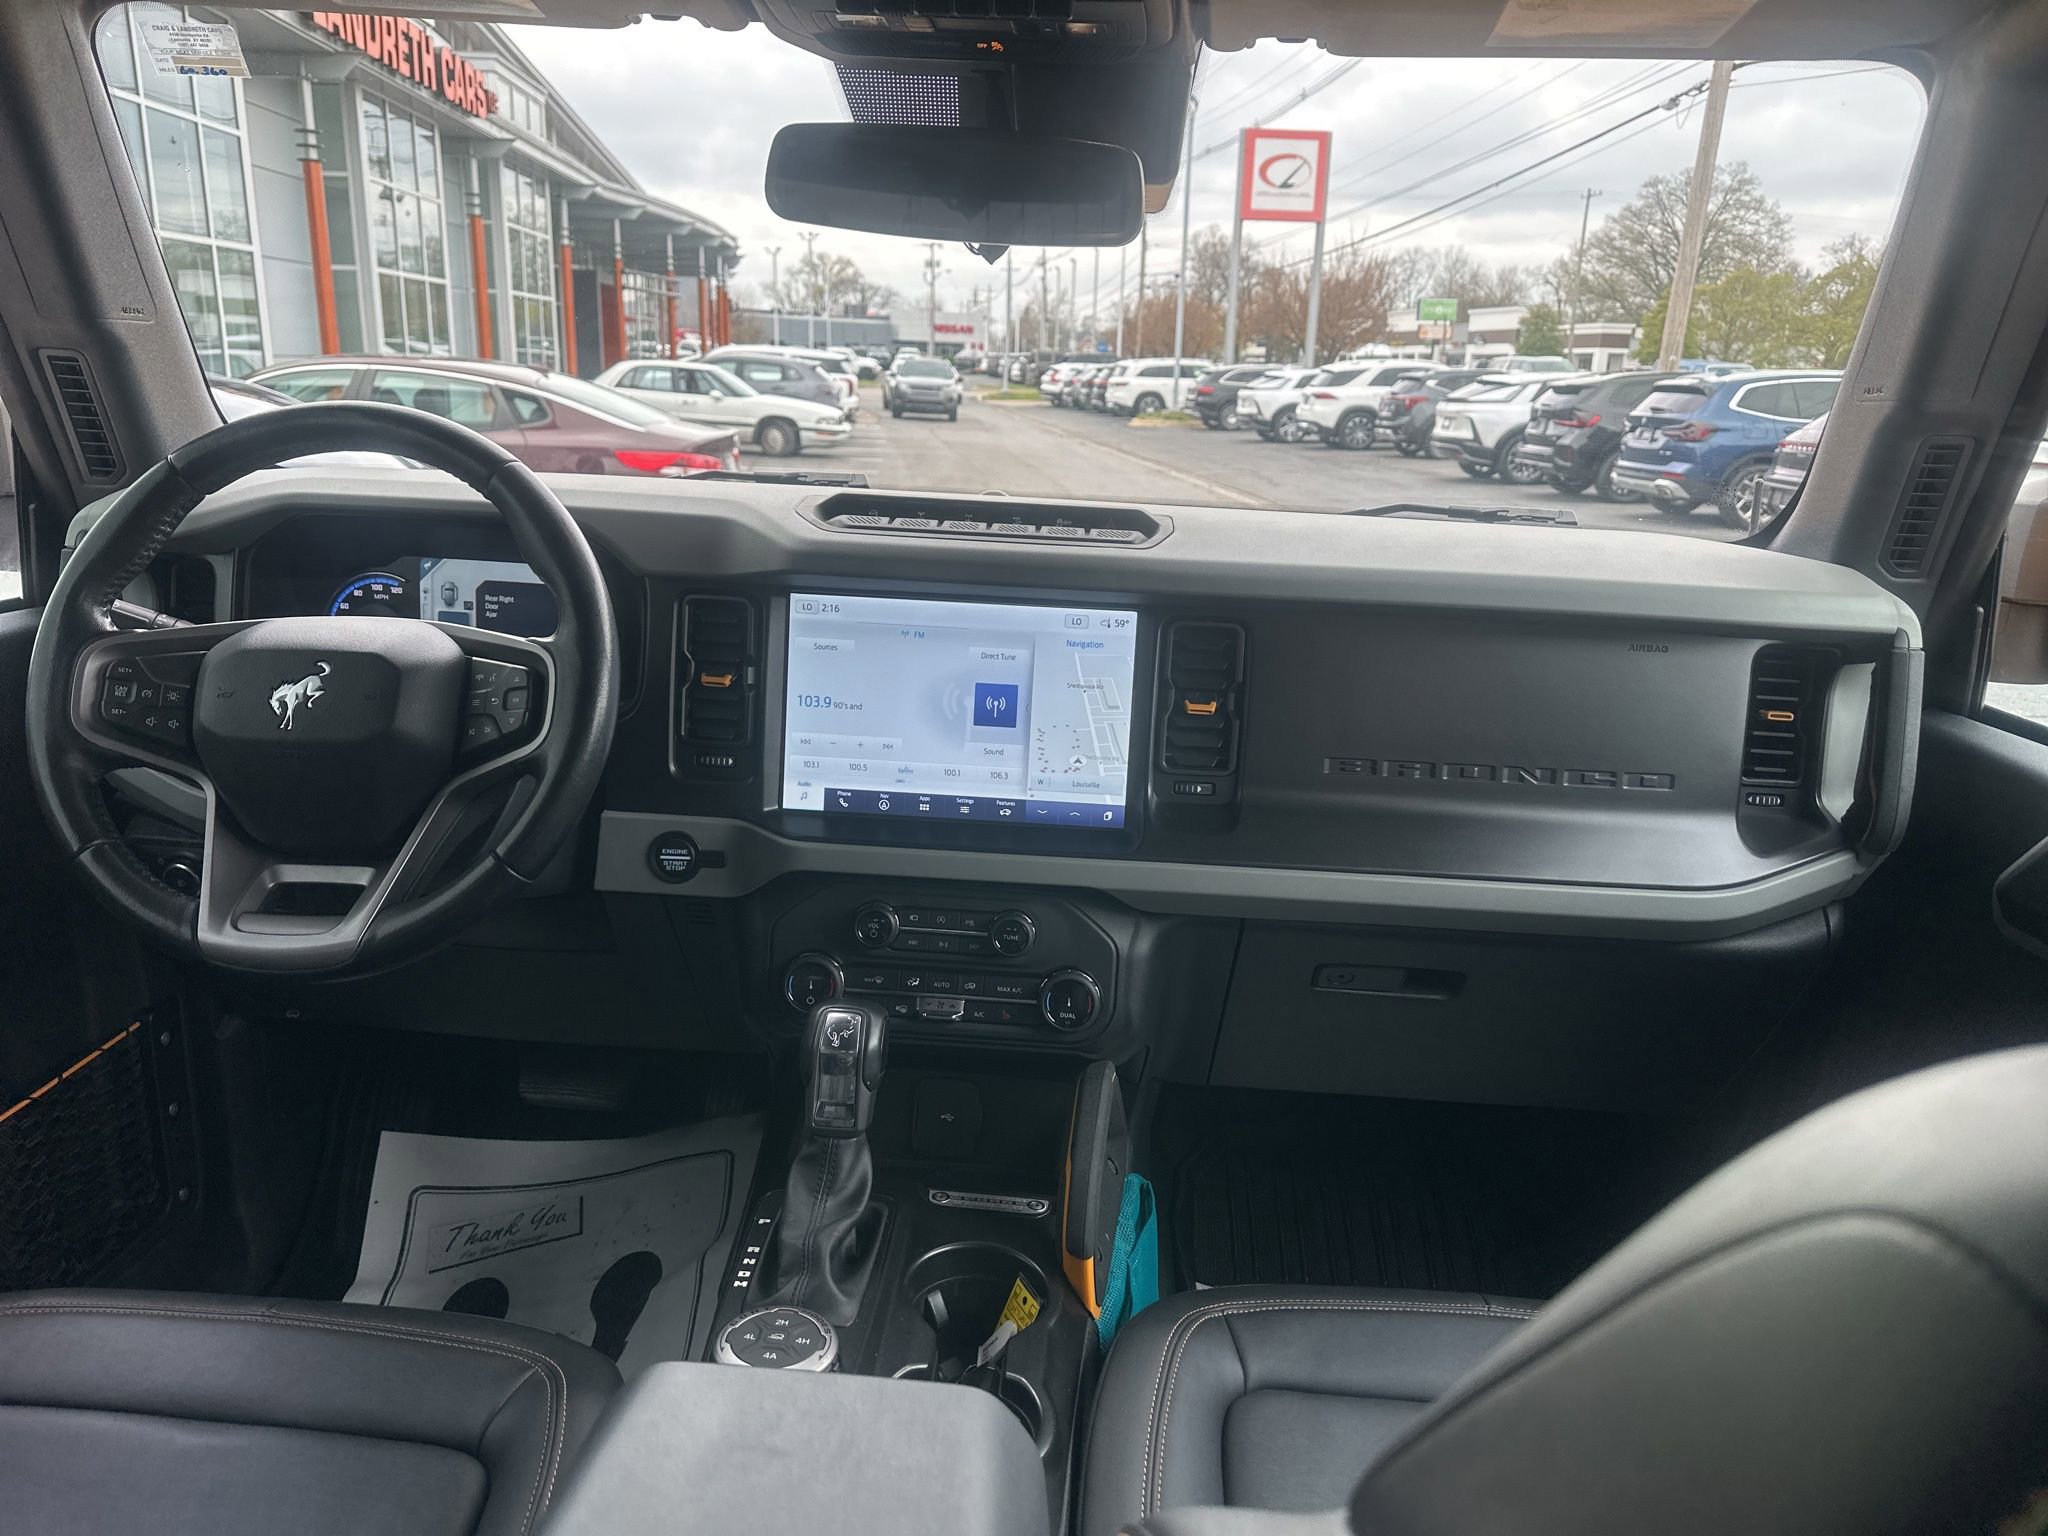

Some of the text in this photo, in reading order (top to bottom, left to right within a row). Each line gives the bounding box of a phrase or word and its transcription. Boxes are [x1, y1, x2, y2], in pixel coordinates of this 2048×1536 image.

[177, 26, 206, 34] LANDRETH
[441, 47, 488, 119] CARS
[485, 594, 514, 604] Rear Right
[821, 604, 840, 613] 2:16
[1072, 618, 1129, 628] LO 59°
[914, 631, 925, 639] FM
[813, 642, 838, 651] Sources
[1066, 639, 1104, 650] Navigation
[1627, 643, 1669, 654] AIRBAG
[981, 652, 1017, 661] Direct Tune
[797, 694, 863, 711] 103.9 90's and
[983, 747, 1004, 756] Sound
[803, 760, 820, 768] 103.1
[849, 763, 868, 771] 100.5
[943, 768, 961, 777] 100.1
[990, 771, 1009, 780] 106.3
[1323, 757, 1675, 792] BRONCO
[1072, 781, 1100, 789] Louisville
[956, 797, 975, 805] Settings
[1059, 1011, 1077, 1019] DUAL
[445, 1212, 525, 1253] Thank
[530, 1204, 567, 1231] You
[762, 1352, 777, 1360] 4A
